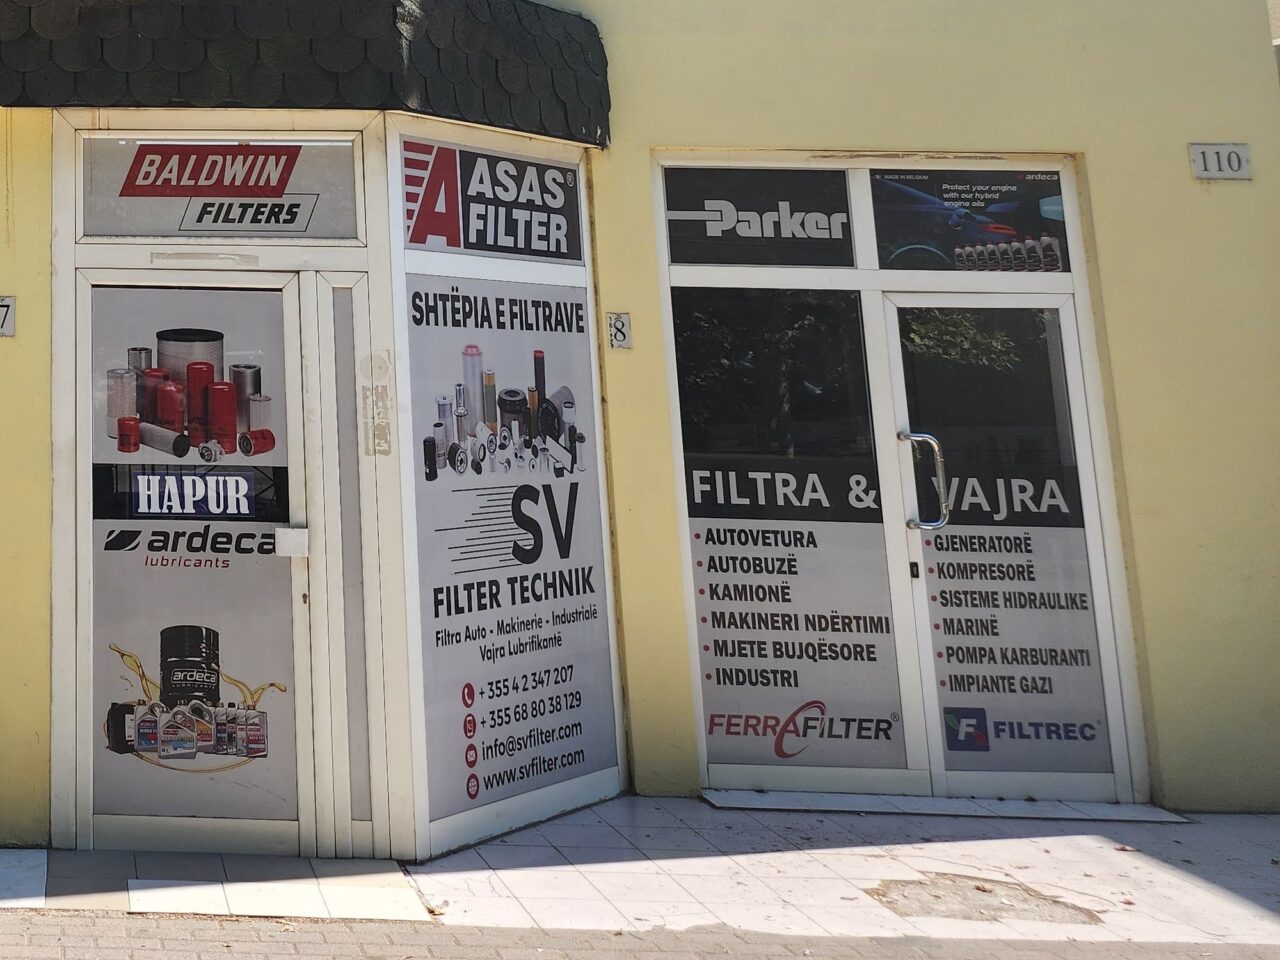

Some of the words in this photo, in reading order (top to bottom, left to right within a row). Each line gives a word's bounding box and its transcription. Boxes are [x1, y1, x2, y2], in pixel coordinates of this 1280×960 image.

[135, 154, 288, 186] BALDWIN
[1200, 151, 1241, 172] 110
[467, 157, 565, 209] ASAS
[1025, 173, 1058, 181] ardeca
[196, 202, 301, 224] FILTERS
[704, 199, 847, 239] Parker
[469, 203, 568, 253] FILTER
[412, 286, 492, 329] SHTËPIA
[495, 298, 506, 329] E
[509, 299, 585, 333] FILTRAVE
[614, 320, 626, 342] 8
[137, 475, 250, 514] HAPUR
[691, 470, 830, 508] FILTRA
[848, 474, 879, 510] &
[931, 477, 1069, 521] VAJRA
[511, 482, 579, 565] SV
[147, 524, 276, 554] ardeca
[705, 528, 818, 548] AUTOVETURA
[934, 532, 1033, 553] GJENERATORË
[145, 555, 230, 568] lubricants
[707, 553, 798, 575] AUTOBUZË
[937, 560, 1036, 581] KOMPRESORË
[434, 579, 502, 618] FILTER
[507, 566, 595, 606] TECHNIK
[709, 581, 792, 603] KAMIONË
[940, 590, 1000, 608] SISTEME
[1004, 592, 1089, 610] HIDRAULIKE
[435, 628, 461, 647] Filtra
[465, 625, 486, 642] Auto
[497, 614, 543, 636] Makinerie
[552, 604, 598, 626] Industrialë
[711, 611, 799, 631] MAKINERI
[805, 610, 890, 634] NDËRTIMI
[943, 614, 1000, 636] MARINË
[480, 642, 505, 664] Vajra
[508, 631, 562, 656] Lubrifikantë
[713, 639, 768, 658] MJETE
[773, 638, 877, 663] BUJQËSORE
[945, 646, 997, 665] POMPA
[1000, 647, 1091, 667] KARBURANTI
[173, 669, 216, 683] ardeca
[531, 669, 551, 690] 347
[554, 664, 573, 684] 207
[715, 668, 799, 687] INDUSTRI
[949, 674, 1015, 693] IMPIANTE
[1020, 676, 1053, 694] GAZI
[514, 703, 528, 722] 68
[531, 699, 546, 718] 80
[548, 695, 561, 714] 38
[564, 691, 581, 710] 129
[482, 721, 582, 760] info@svfilter.com
[993, 721, 1096, 741] FILTREC
[483, 749, 584, 790] www.svfilter.com
